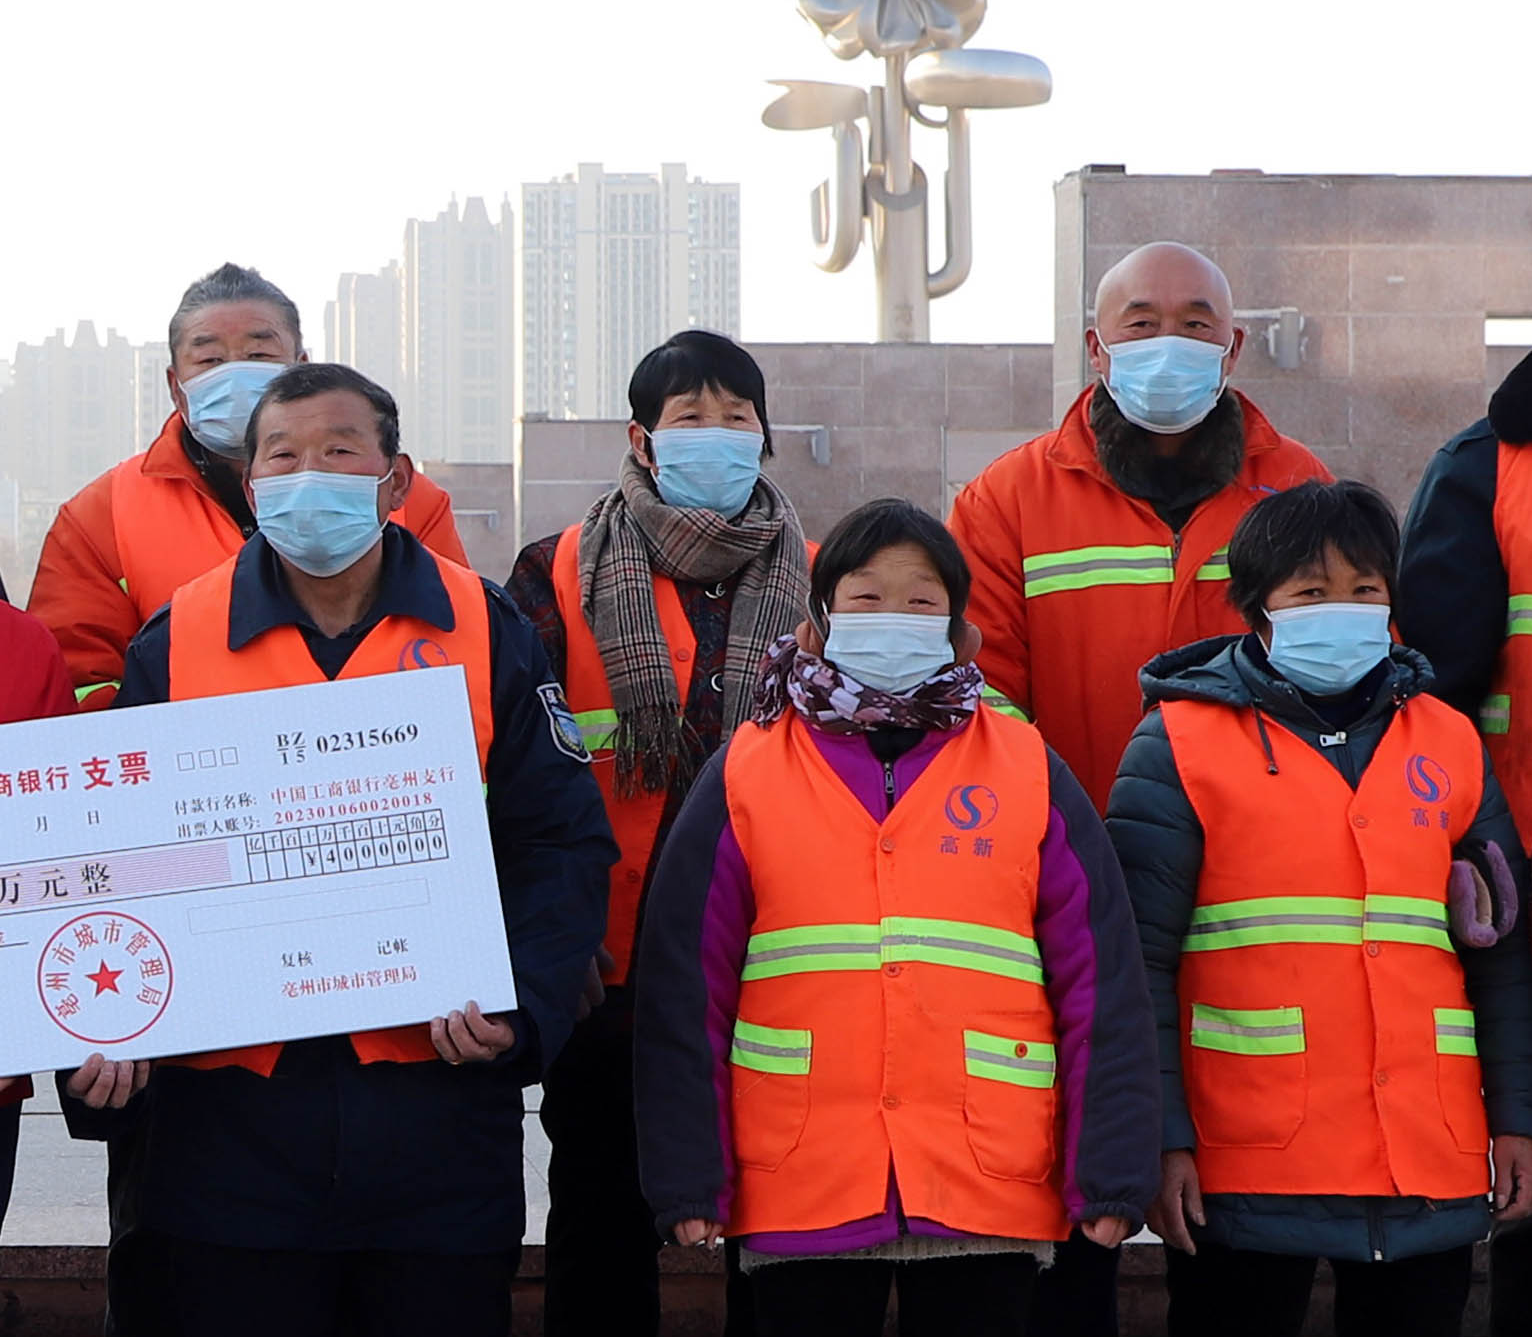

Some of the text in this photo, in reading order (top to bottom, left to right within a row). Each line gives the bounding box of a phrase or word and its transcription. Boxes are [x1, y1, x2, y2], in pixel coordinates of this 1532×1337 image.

[316, 723, 419, 754] 02315669
[81, 751, 151, 791] 支票
[175, 792, 257, 815] 付款行名称:
[274, 792, 433, 825] 202301060020018
[35, 816, 48, 833] 月
[87, 810, 100, 825] 日
[939, 835, 994, 858] 高新
